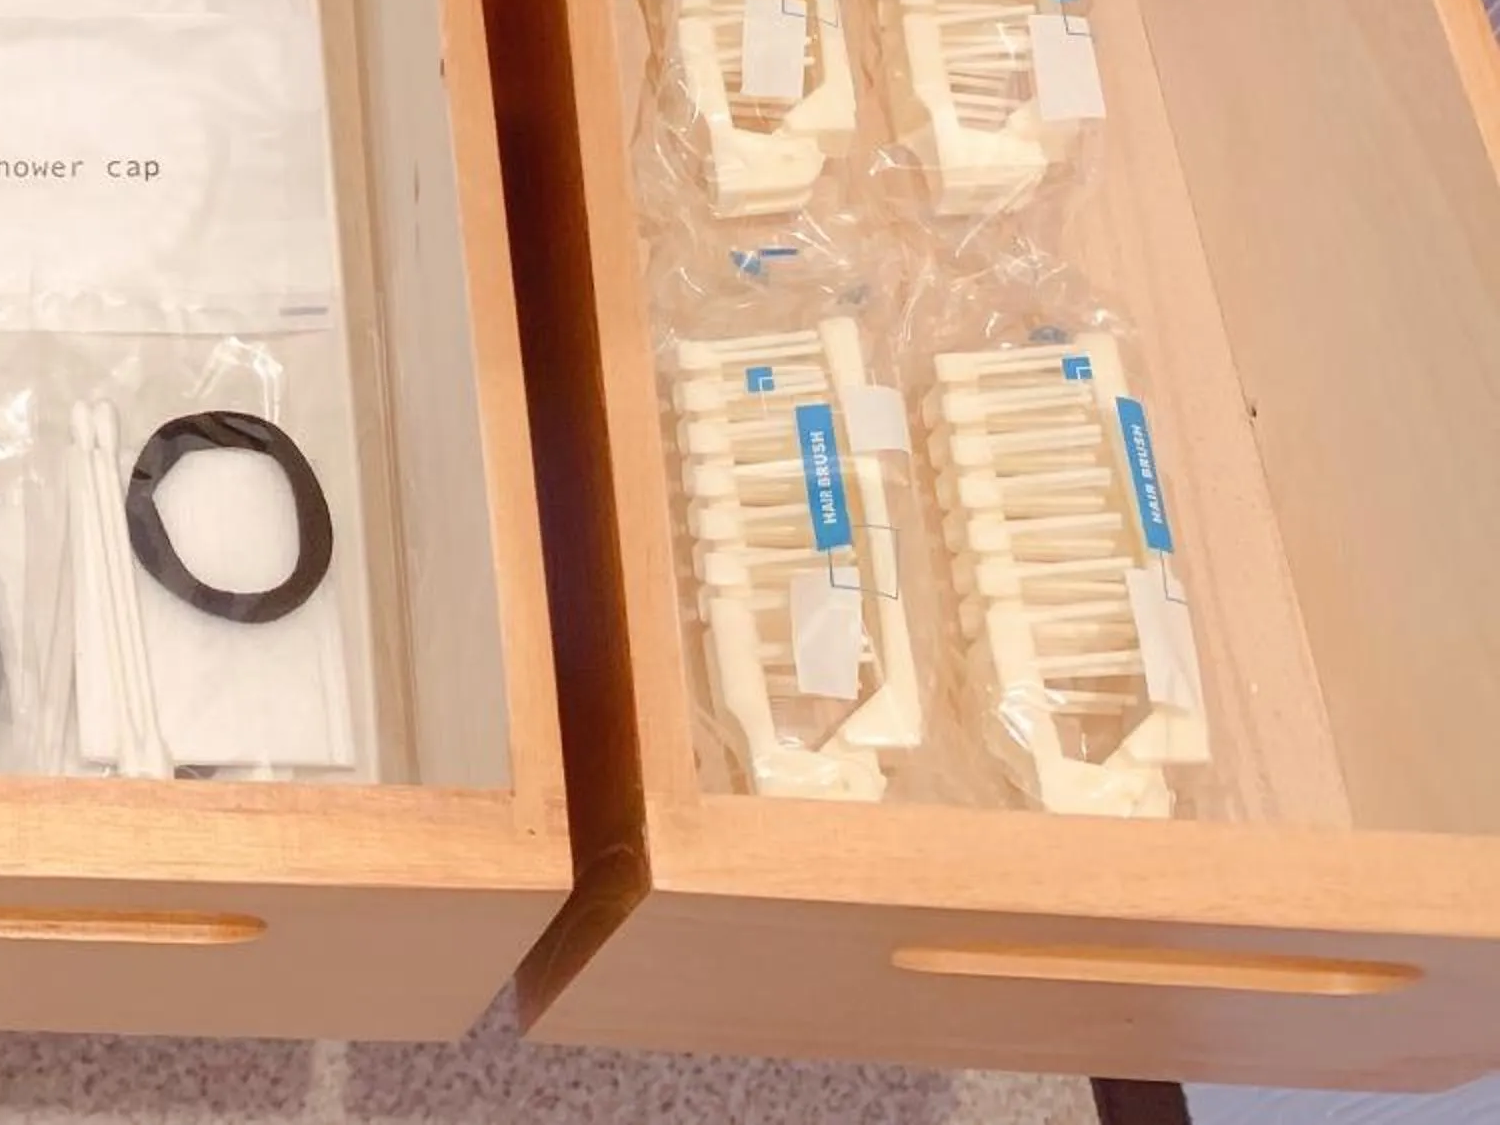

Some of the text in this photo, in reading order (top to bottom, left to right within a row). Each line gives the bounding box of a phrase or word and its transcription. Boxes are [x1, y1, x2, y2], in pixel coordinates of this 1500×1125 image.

[106, 157, 161, 181] cap
[810, 431, 837, 524] HAIR BRUSH
[1130, 424, 1163, 524] HAIR BRUSH
